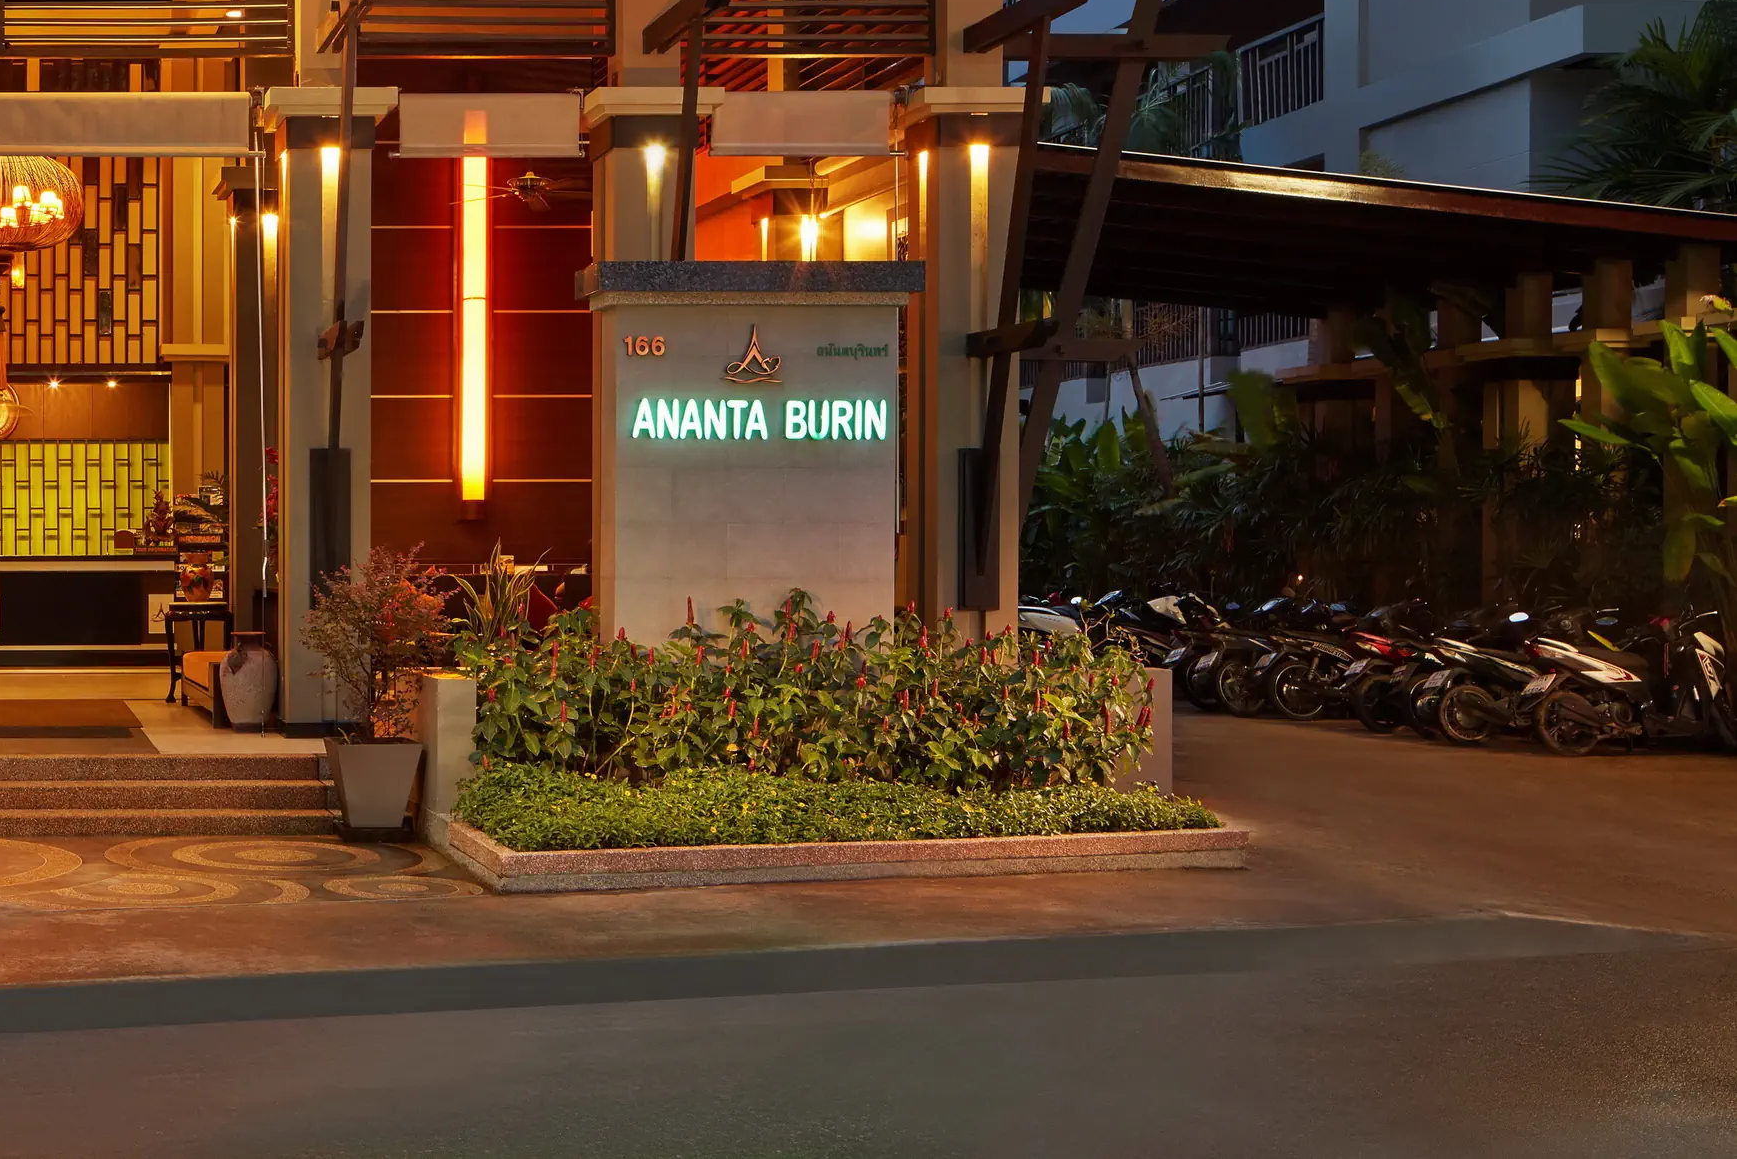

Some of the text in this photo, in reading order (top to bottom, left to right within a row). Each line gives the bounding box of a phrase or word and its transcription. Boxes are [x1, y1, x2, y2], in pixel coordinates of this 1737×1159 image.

[623, 335, 666, 356] 166
[632, 398, 887, 440] ANANTA BURIN
